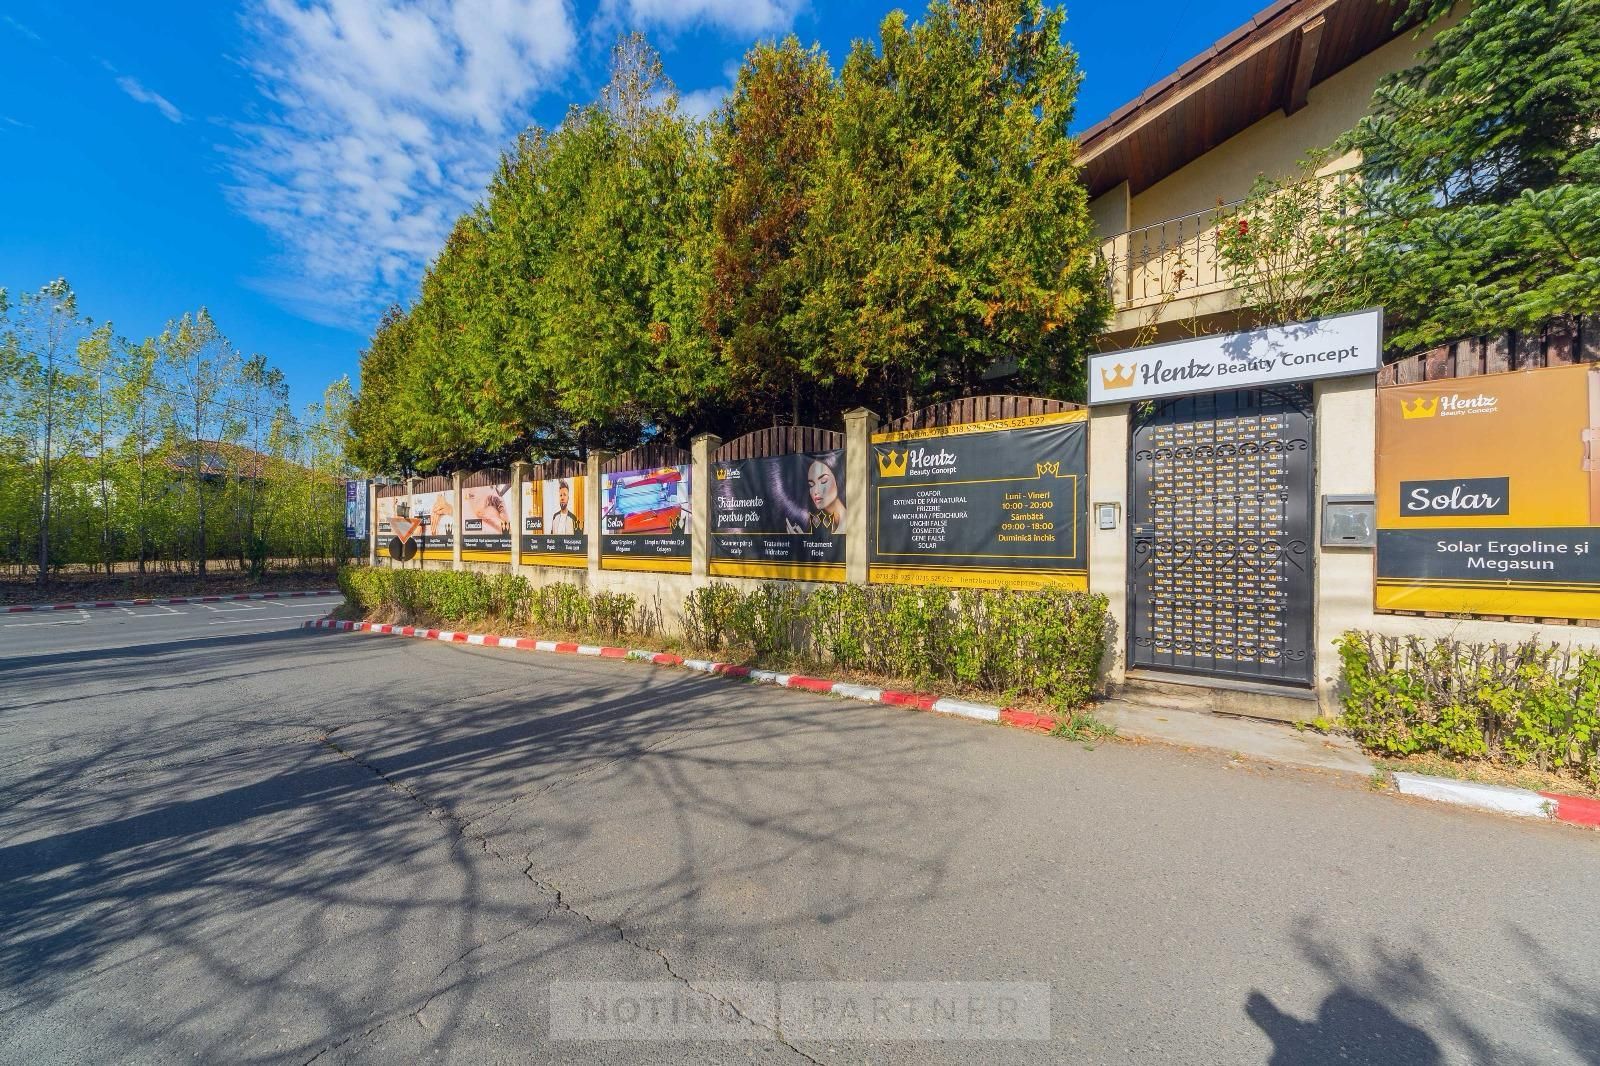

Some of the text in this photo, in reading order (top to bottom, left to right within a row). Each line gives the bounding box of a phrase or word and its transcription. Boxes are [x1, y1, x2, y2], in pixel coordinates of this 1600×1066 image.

[1140, 345, 1358, 385] Hentz Beauty Concept
[1440, 393, 1498, 410] Hentz
[1440, 406, 1498, 417] Beauty Concept
[909, 448, 958, 467] Hentz
[932, 466, 957, 474] Concept
[717, 495, 763, 509] Tratamente
[1005, 492, 1021, 500] Luni
[1028, 491, 1050, 499] Vineri
[1407, 486, 1501, 511] Solar
[1029, 501, 1053, 509] 20:00
[717, 511, 760, 527] pentru păr
[1032, 522, 1054, 530] 18:00
[998, 534, 1032, 542] Duminică
[1436, 541, 1589, 556] Solar Ergoline și
[1467, 557, 1554, 572] Megasun
